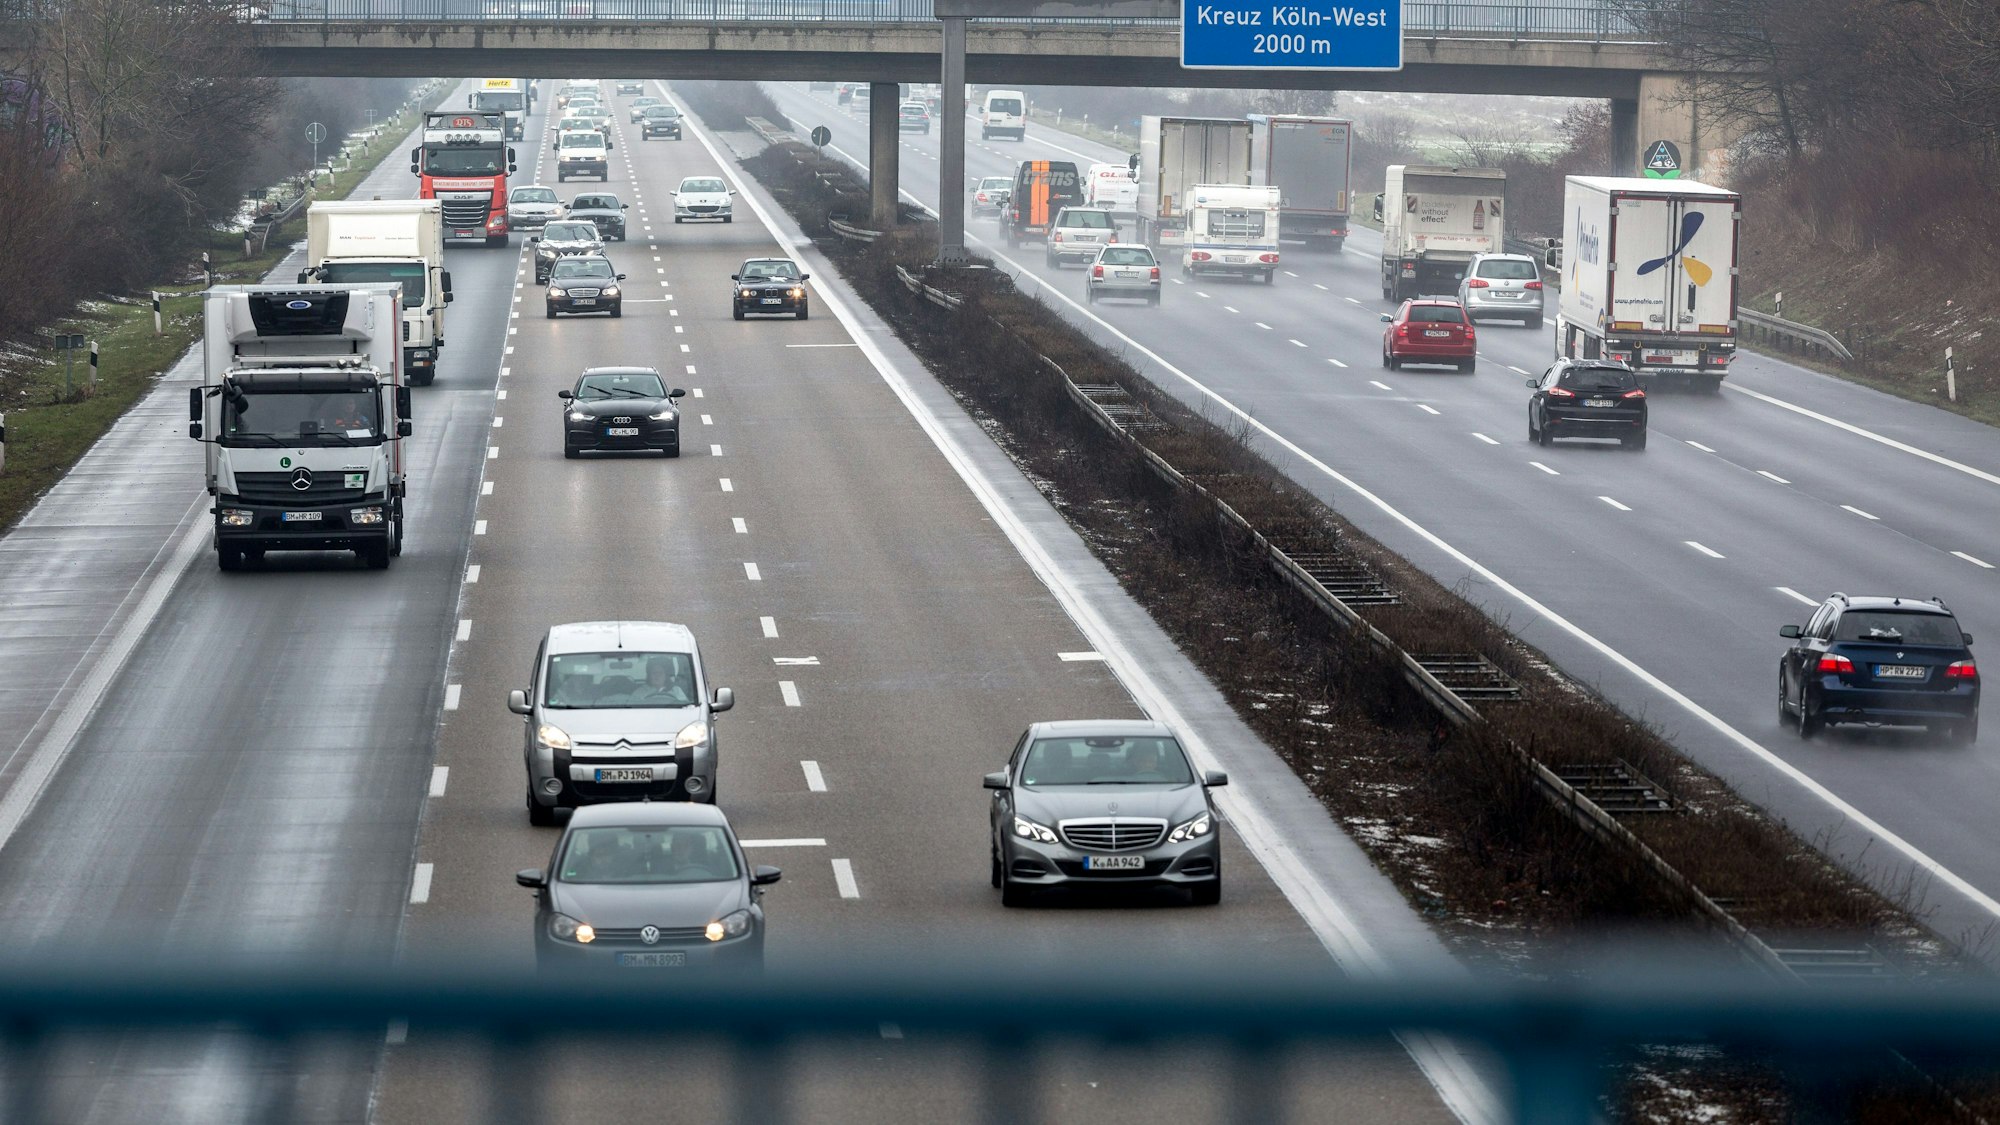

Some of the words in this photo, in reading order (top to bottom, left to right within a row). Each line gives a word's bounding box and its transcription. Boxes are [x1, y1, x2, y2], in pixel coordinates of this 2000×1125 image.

[1197, 5, 1262, 25] Kreuz
[1272, 6, 1387, 26] Köln-West
[1253, 34, 1306, 54] 2000
[1311, 39, 1331, 54] m
[1023, 167, 1075, 187] trans
[1421, 208, 1449, 216] without
[286, 512, 296, 520] BM
[298, 512, 308, 520] HR
[308, 512, 321, 520] 109
[1906, 666, 1924, 676] 2712
[601, 770, 612, 780] BM
[618, 770, 629, 780] PJ
[630, 770, 651, 780] 1964
[1106, 857, 1120, 868] AA
[1121, 857, 1141, 868] 942
